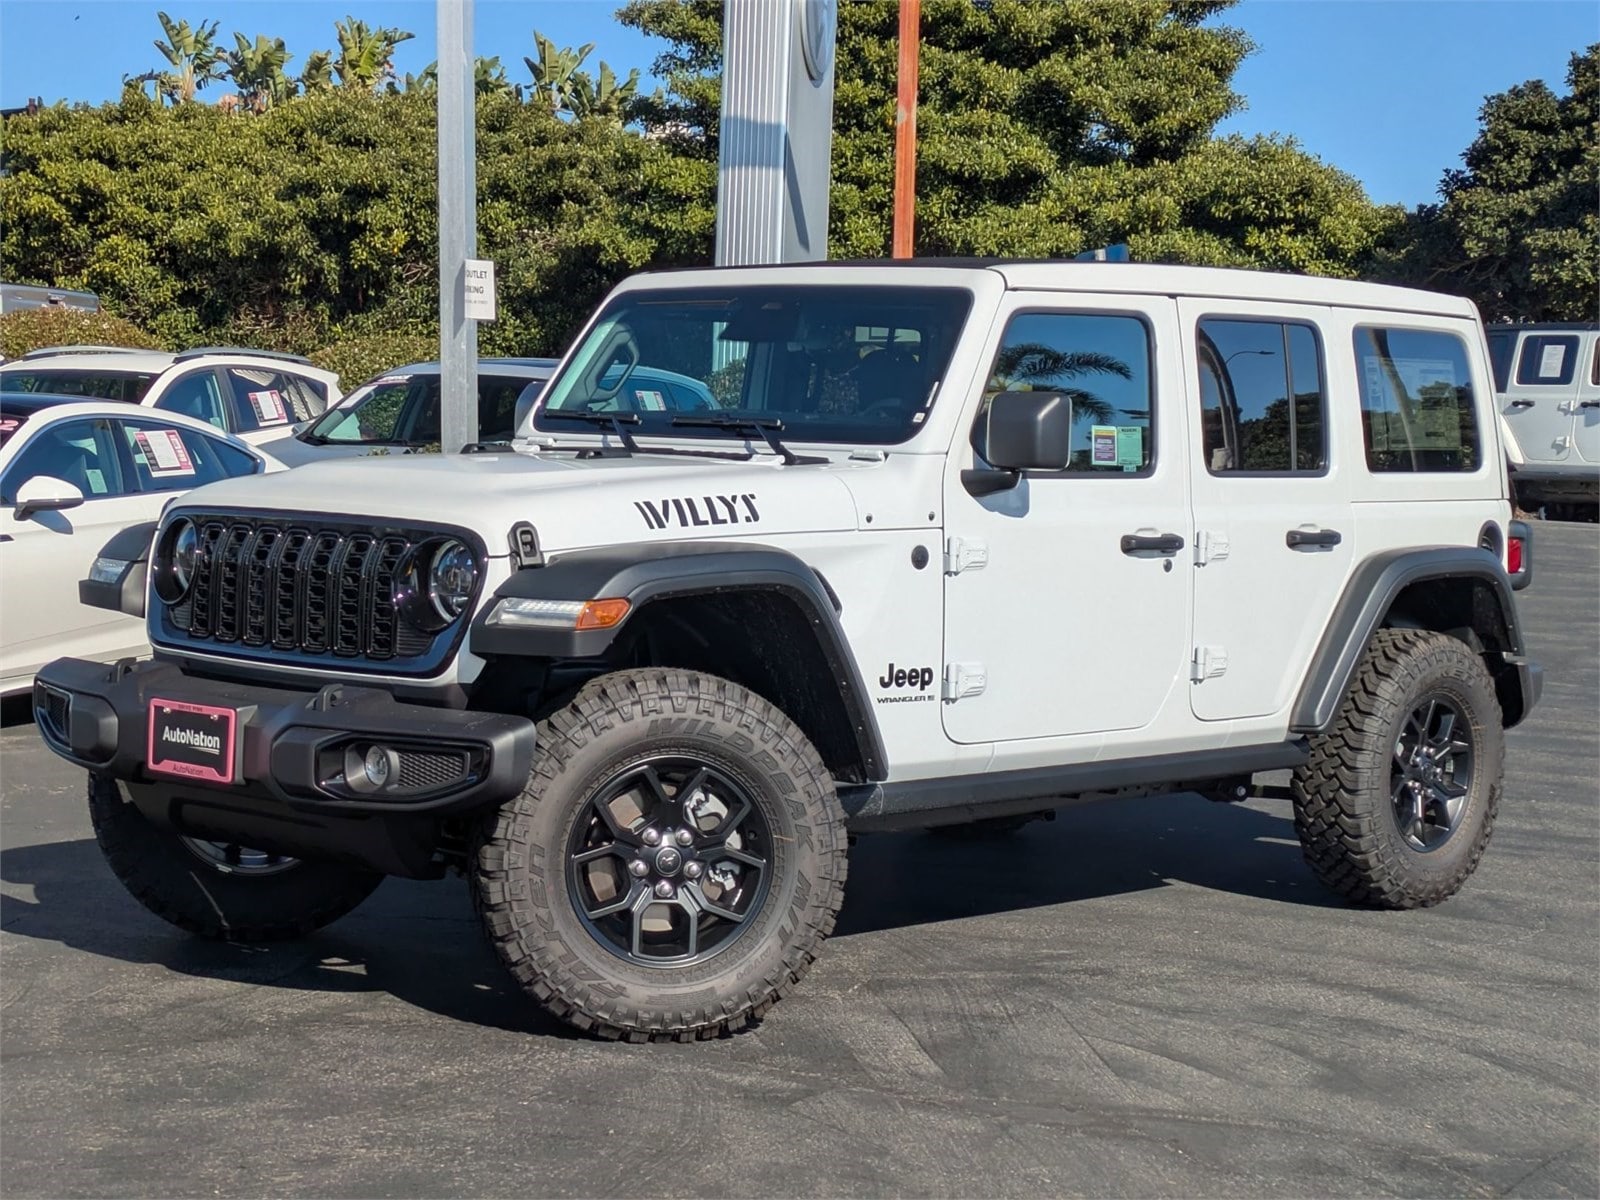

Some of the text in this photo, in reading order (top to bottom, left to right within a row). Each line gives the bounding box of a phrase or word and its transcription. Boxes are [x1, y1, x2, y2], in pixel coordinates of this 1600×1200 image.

[466, 270, 487, 279] OUTLET
[633, 493, 760, 529] WILLYS
[879, 663, 934, 691] Jeep
[877, 696, 926, 704] WRANGLER
[162, 726, 220, 748] AutoNation
[172, 763, 204, 776] AutoNation
[646, 717, 815, 853] WILDPEAK
[528, 842, 630, 999] FALKEN
